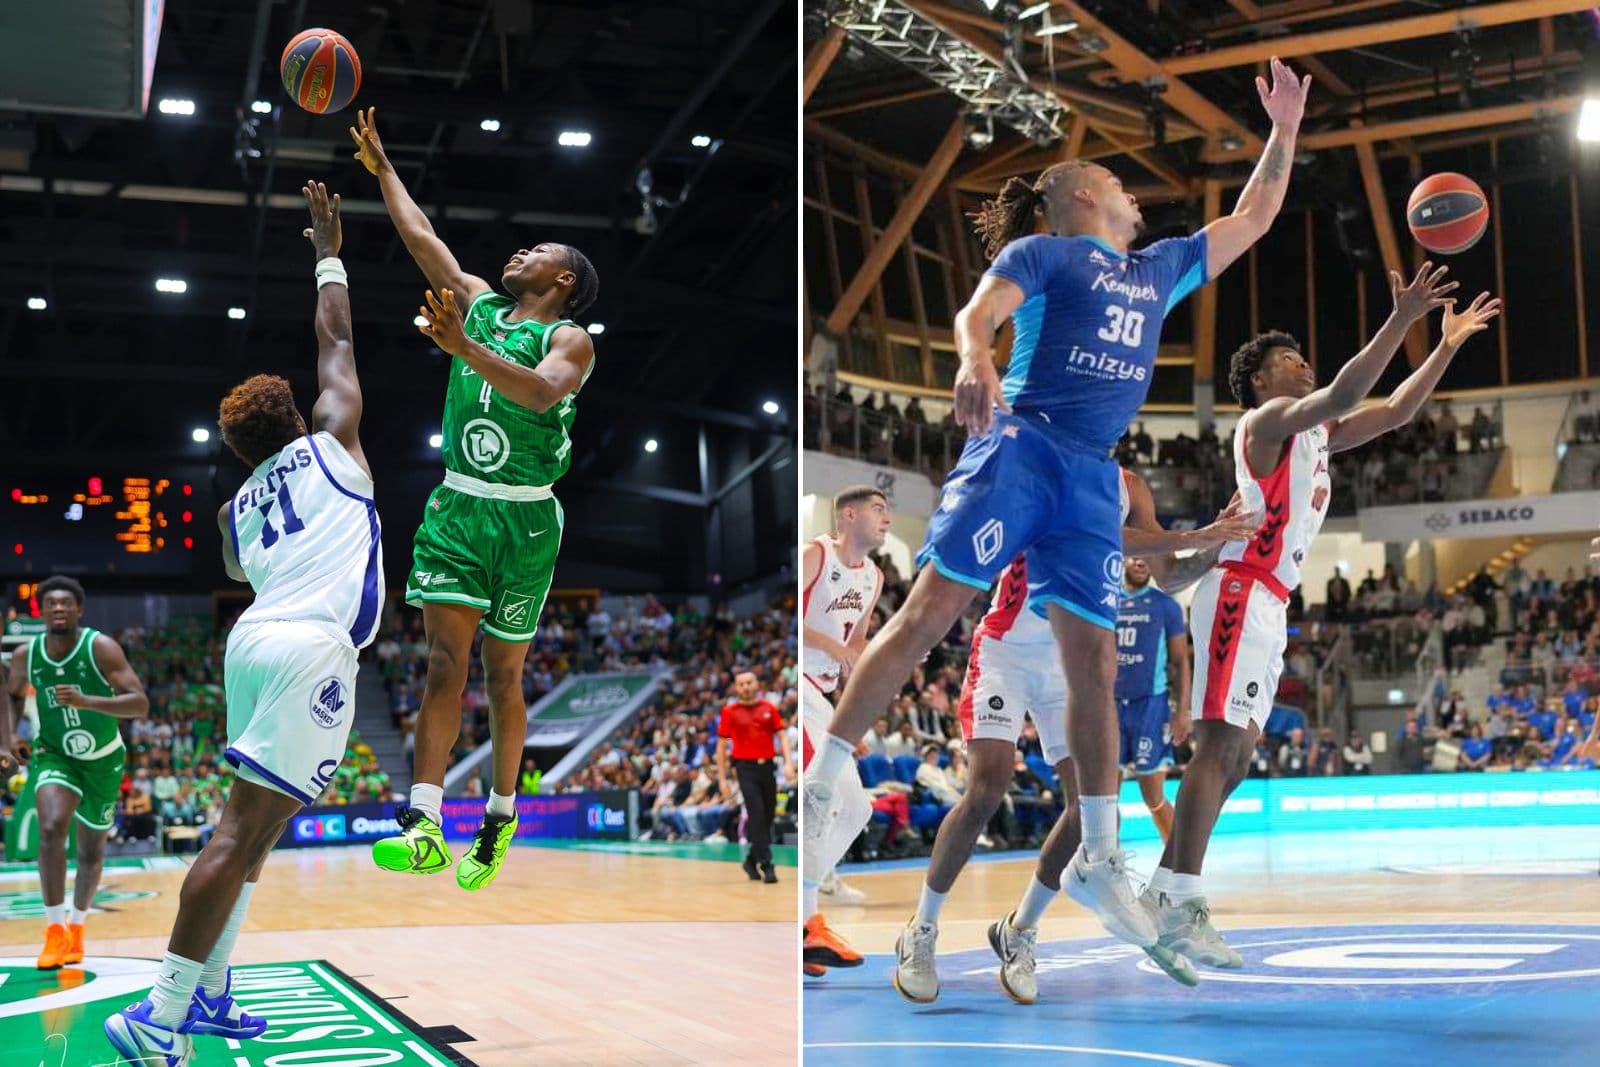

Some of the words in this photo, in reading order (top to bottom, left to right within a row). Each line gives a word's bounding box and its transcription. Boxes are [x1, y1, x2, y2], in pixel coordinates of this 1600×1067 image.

[1090, 271, 1158, 305] Kemper
[1098, 304, 1145, 348] 30
[1068, 346, 1146, 381] inizys
[1459, 506, 1535, 525] SEBACO
[62, 706, 81, 729] 19
[312, 704, 334, 726] BASKET
[298, 817, 340, 838] CIC
[230, 966, 375, 1043] SIDAMO
